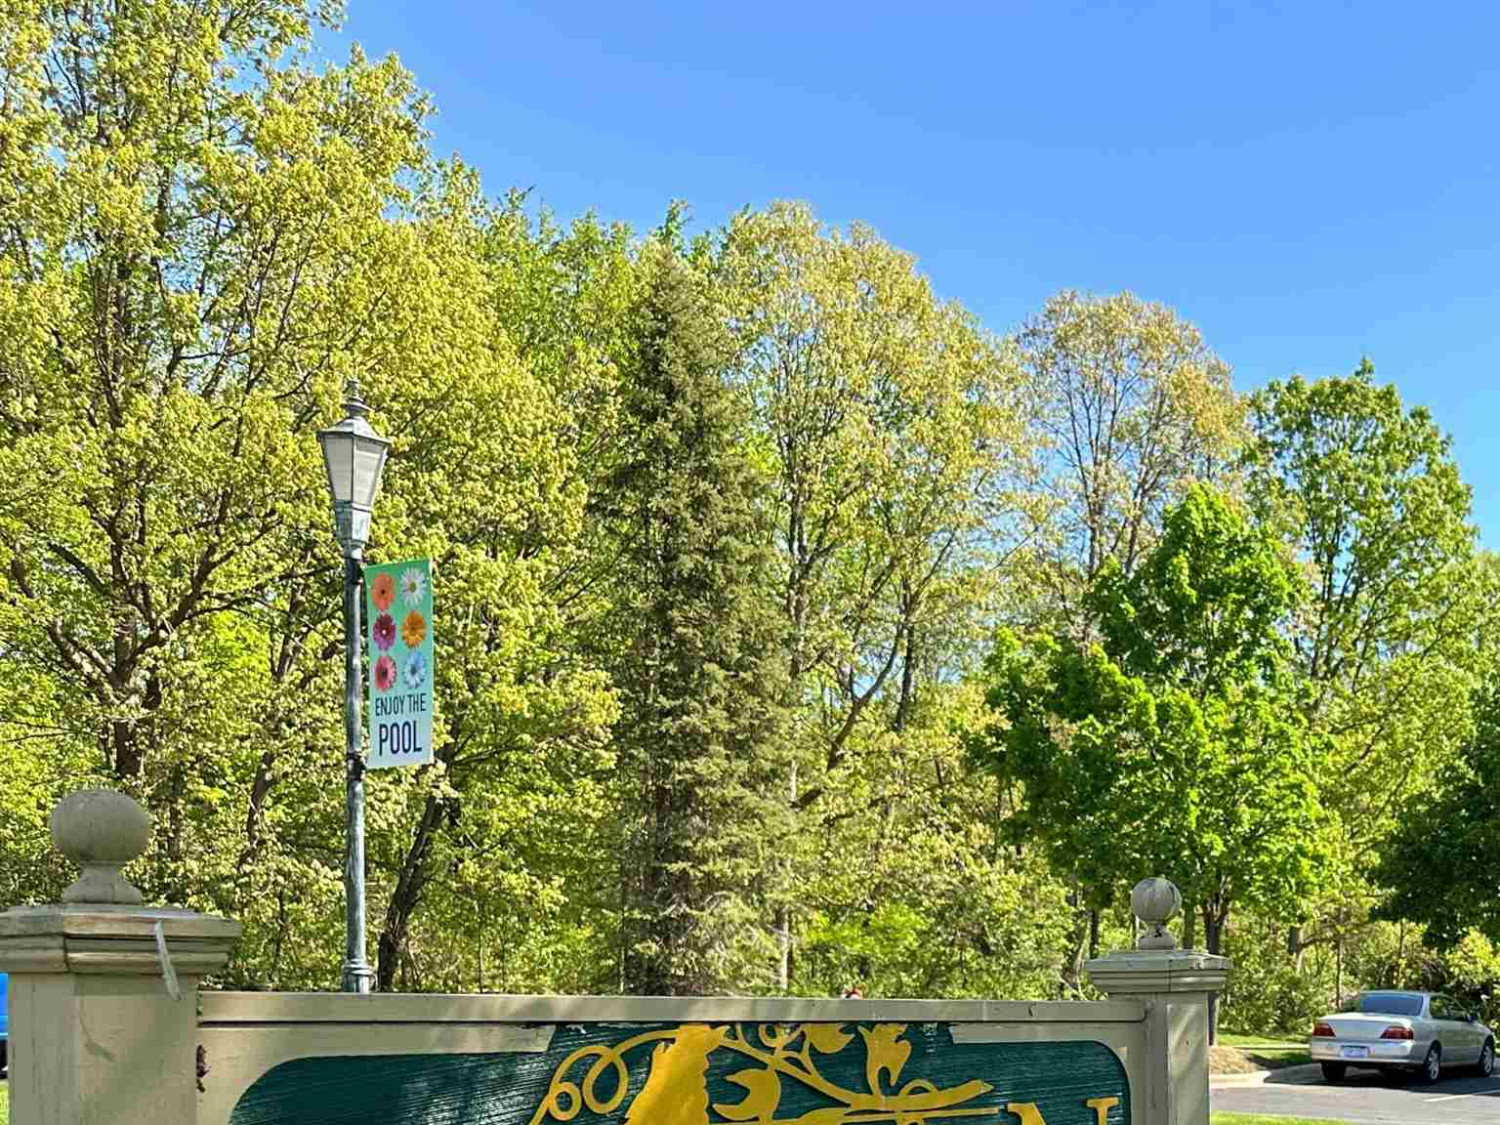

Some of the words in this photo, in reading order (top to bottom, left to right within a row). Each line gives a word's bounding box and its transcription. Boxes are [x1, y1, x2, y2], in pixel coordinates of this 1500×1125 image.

[375, 695, 405, 717] ENJOY
[407, 693, 427, 713] THE
[379, 720, 422, 756] POOL
